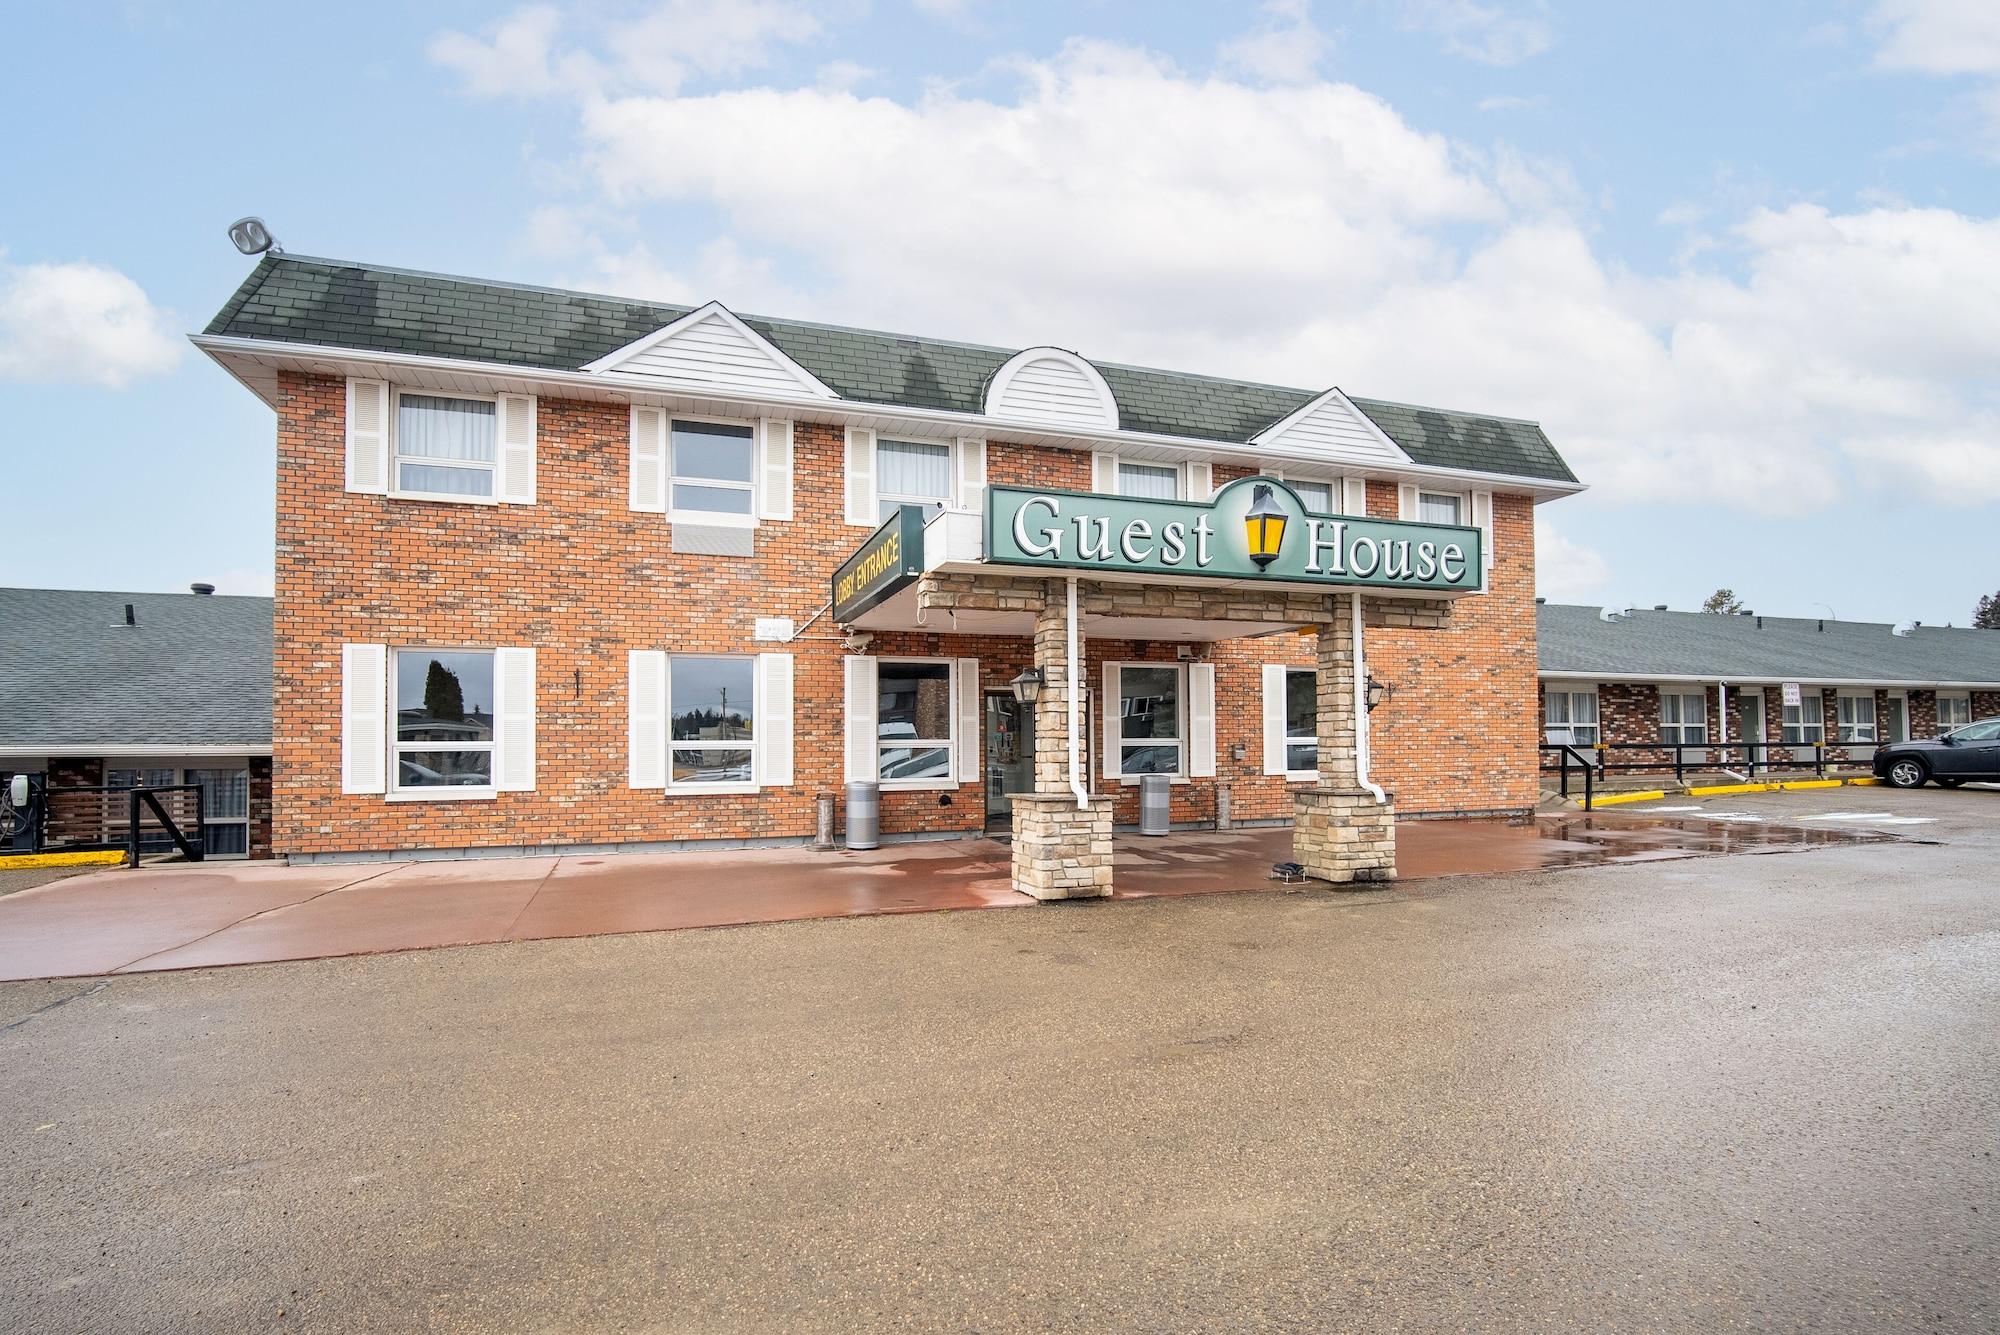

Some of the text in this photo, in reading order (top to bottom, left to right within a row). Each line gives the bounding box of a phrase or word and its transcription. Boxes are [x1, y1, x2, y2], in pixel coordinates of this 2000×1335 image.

[835, 532, 899, 606] LOBBY ENTRANCE
[1013, 496, 1466, 583] Guest House
